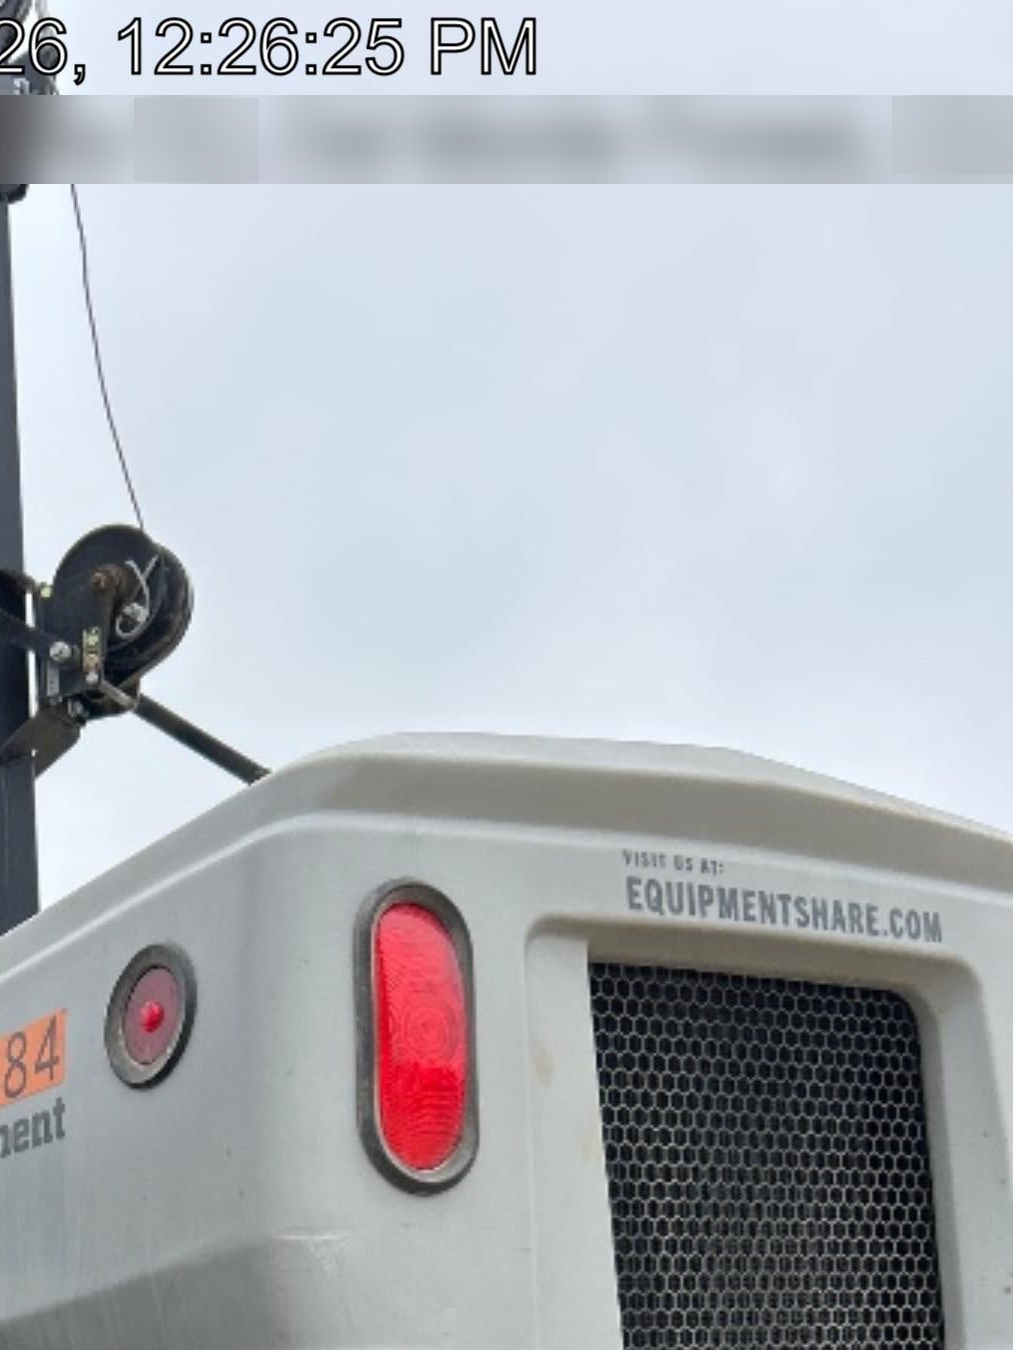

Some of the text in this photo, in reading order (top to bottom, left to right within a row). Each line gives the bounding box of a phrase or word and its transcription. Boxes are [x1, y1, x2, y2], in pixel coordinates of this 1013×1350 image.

[622, 848, 724, 877] VISIT US AT:
[625, 875, 943, 943] EQUIPMENTSHARE.COM
